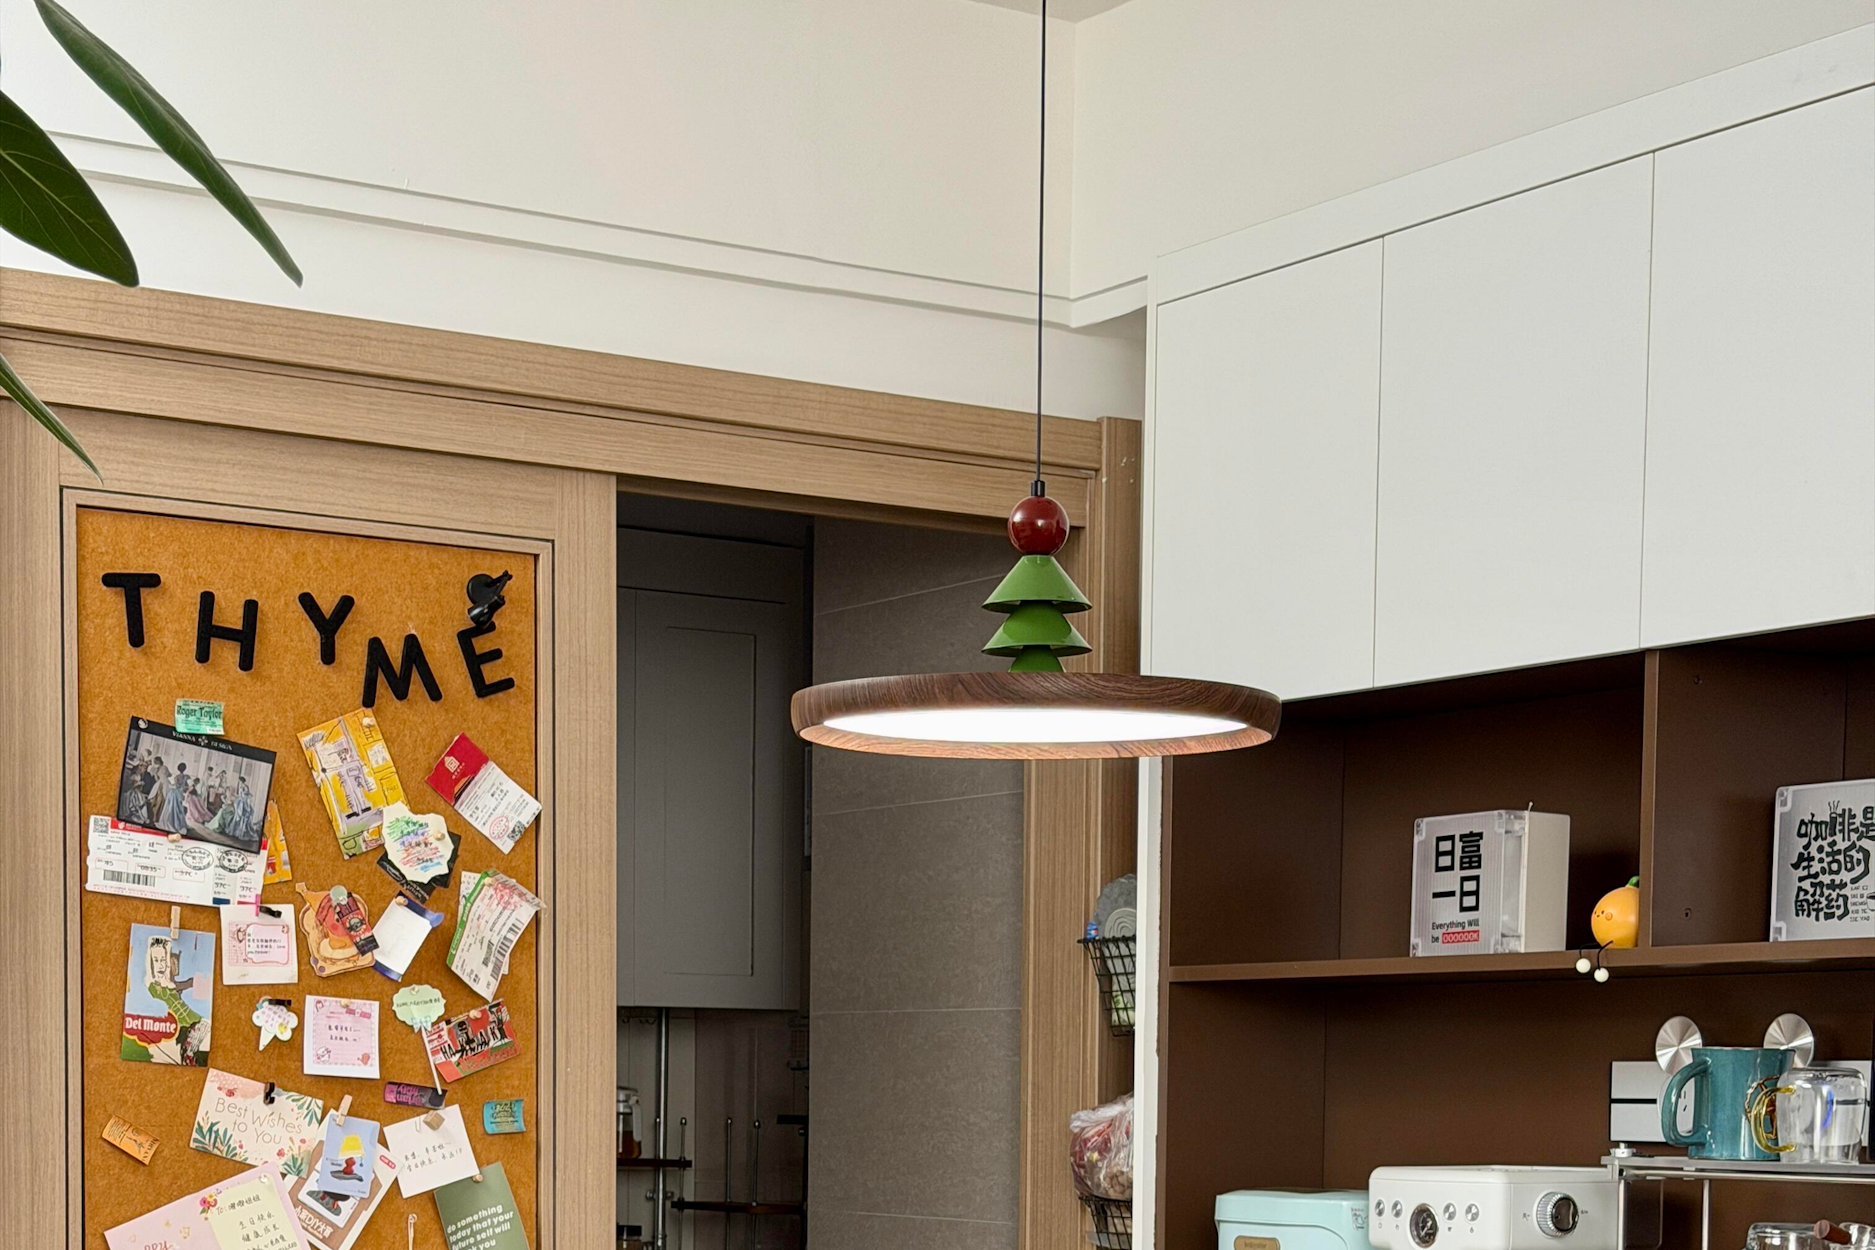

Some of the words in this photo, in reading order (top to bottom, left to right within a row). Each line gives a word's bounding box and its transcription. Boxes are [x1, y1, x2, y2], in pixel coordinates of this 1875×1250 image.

[101, 572, 516, 708] THYME
[177, 706, 197, 718] Roger
[200, 707, 222, 720] Taylor
[1797, 807, 1875, 851] 咖啡是
[1435, 831, 1483, 873] 日富
[1790, 839, 1871, 885] 生活的
[1432, 875, 1480, 913] 一日
[1794, 878, 1849, 922] 解药
[1431, 935, 1440, 943] be
[1432, 920, 1466, 931] Everything
[1467, 918, 1479, 928] Will
[125, 1017, 142, 1029] Del
[143, 1019, 177, 1034] Monte
[215, 1098, 248, 1118] Best
[252, 1110, 302, 1134] Wishes
[232, 1119, 247, 1133] to
[255, 1128, 282, 1145] You
[447, 1224, 456, 1233] do
[457, 1204, 503, 1228] something
[449, 1227, 471, 1242] today
[472, 1218, 491, 1232] that
[493, 1211, 513, 1225] your
[476, 1228, 493, 1241] self
[494, 1221, 510, 1234] will
